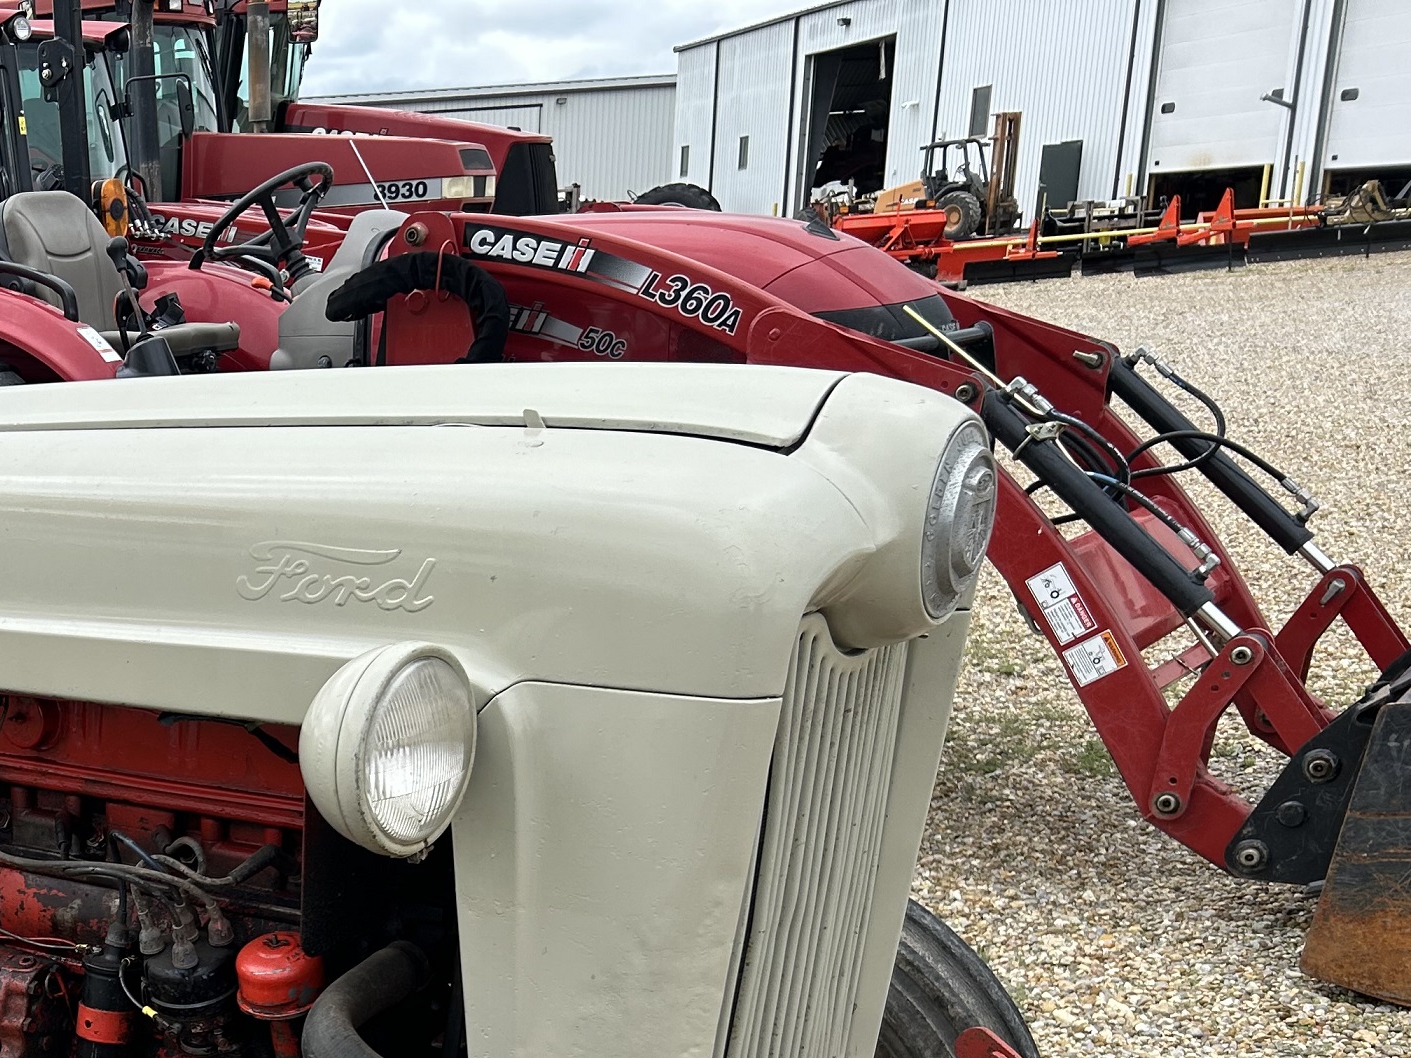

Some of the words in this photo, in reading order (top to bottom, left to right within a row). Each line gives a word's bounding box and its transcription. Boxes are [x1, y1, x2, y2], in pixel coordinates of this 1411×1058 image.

[373, 181, 428, 201] 8930
[639, 271, 744, 335] L360A
[236, 541, 436, 613] Ford
[1075, 603, 1092, 628] DANGER
